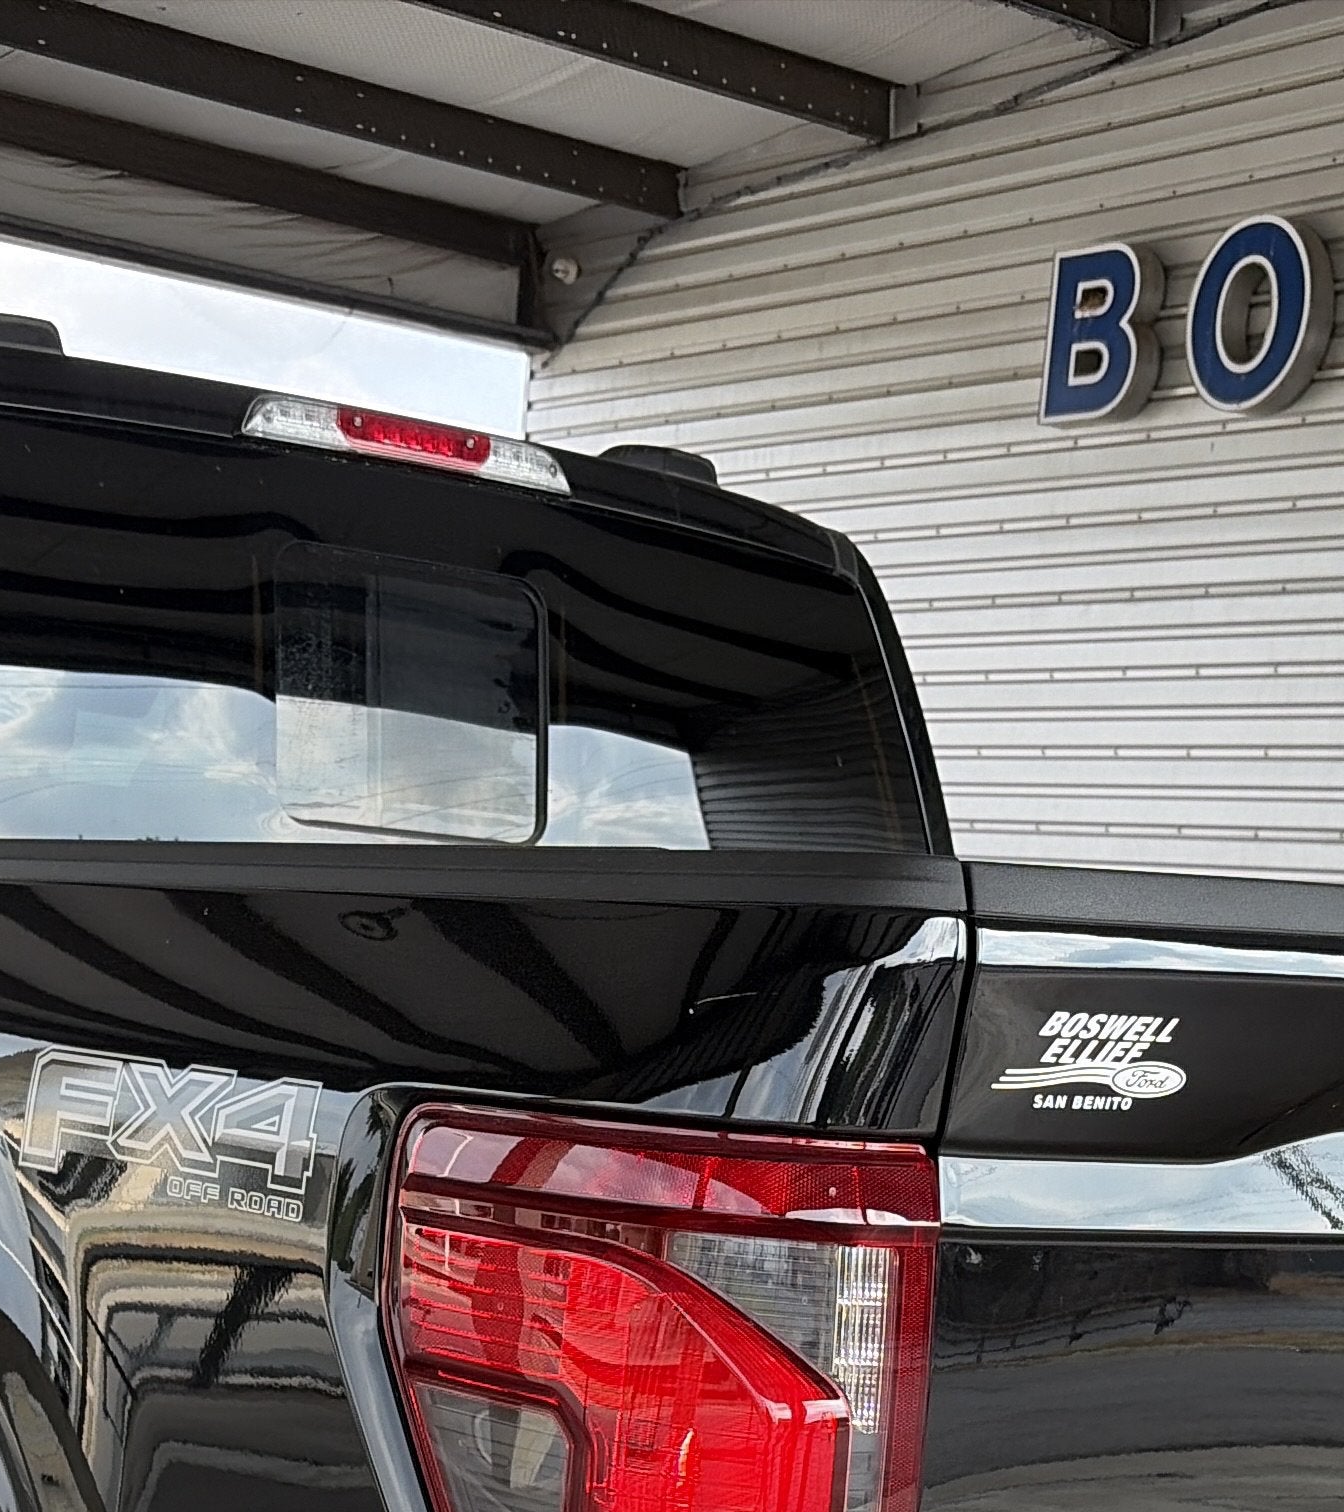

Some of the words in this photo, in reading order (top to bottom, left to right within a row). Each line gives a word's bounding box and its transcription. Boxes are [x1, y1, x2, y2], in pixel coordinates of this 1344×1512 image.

[1039, 1010, 1181, 1044] BOSWELL
[1039, 1037, 1151, 1066] ELLIFF
[1125, 1070, 1170, 1091] Ford
[1032, 1094, 1068, 1110] SAN
[1071, 1095, 1133, 1112] BENITO
[18, 1044, 324, 1195] FX4
[166, 1176, 220, 1204] OFF
[227, 1187, 304, 1223] ROAD
